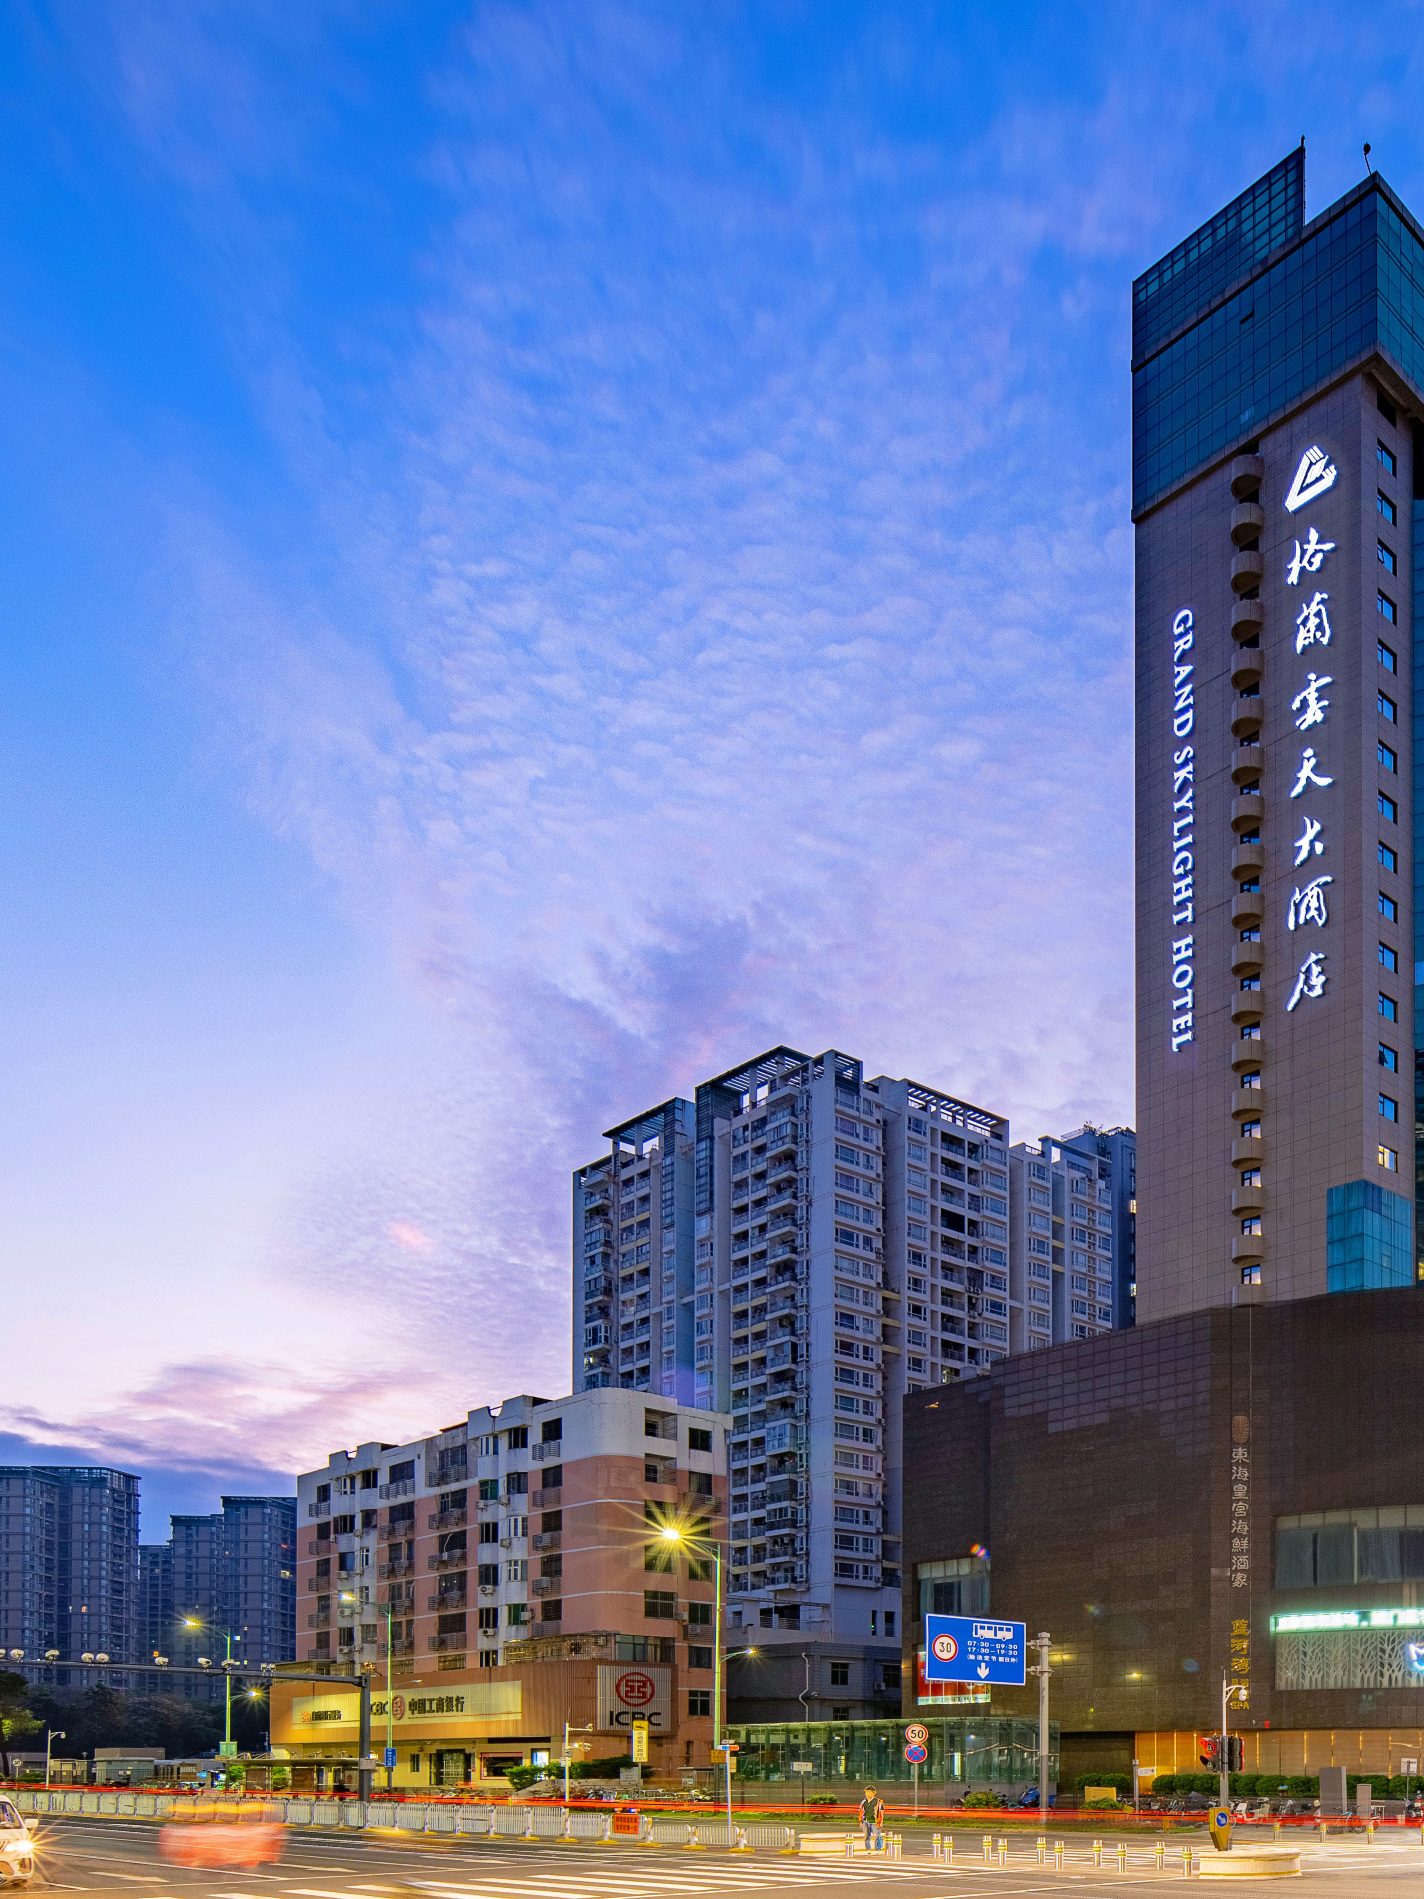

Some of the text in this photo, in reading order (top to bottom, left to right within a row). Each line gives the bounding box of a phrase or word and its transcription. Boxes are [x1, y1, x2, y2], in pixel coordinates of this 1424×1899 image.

[1171, 608, 1195, 1053] GRAND SKYLIGHT HOTEL
[939, 1642, 952, 1653] 30
[369, 1700, 388, 1715] CBC
[408, 1695, 465, 1715] 中国工商银行
[910, 1729, 924, 1740] 50
